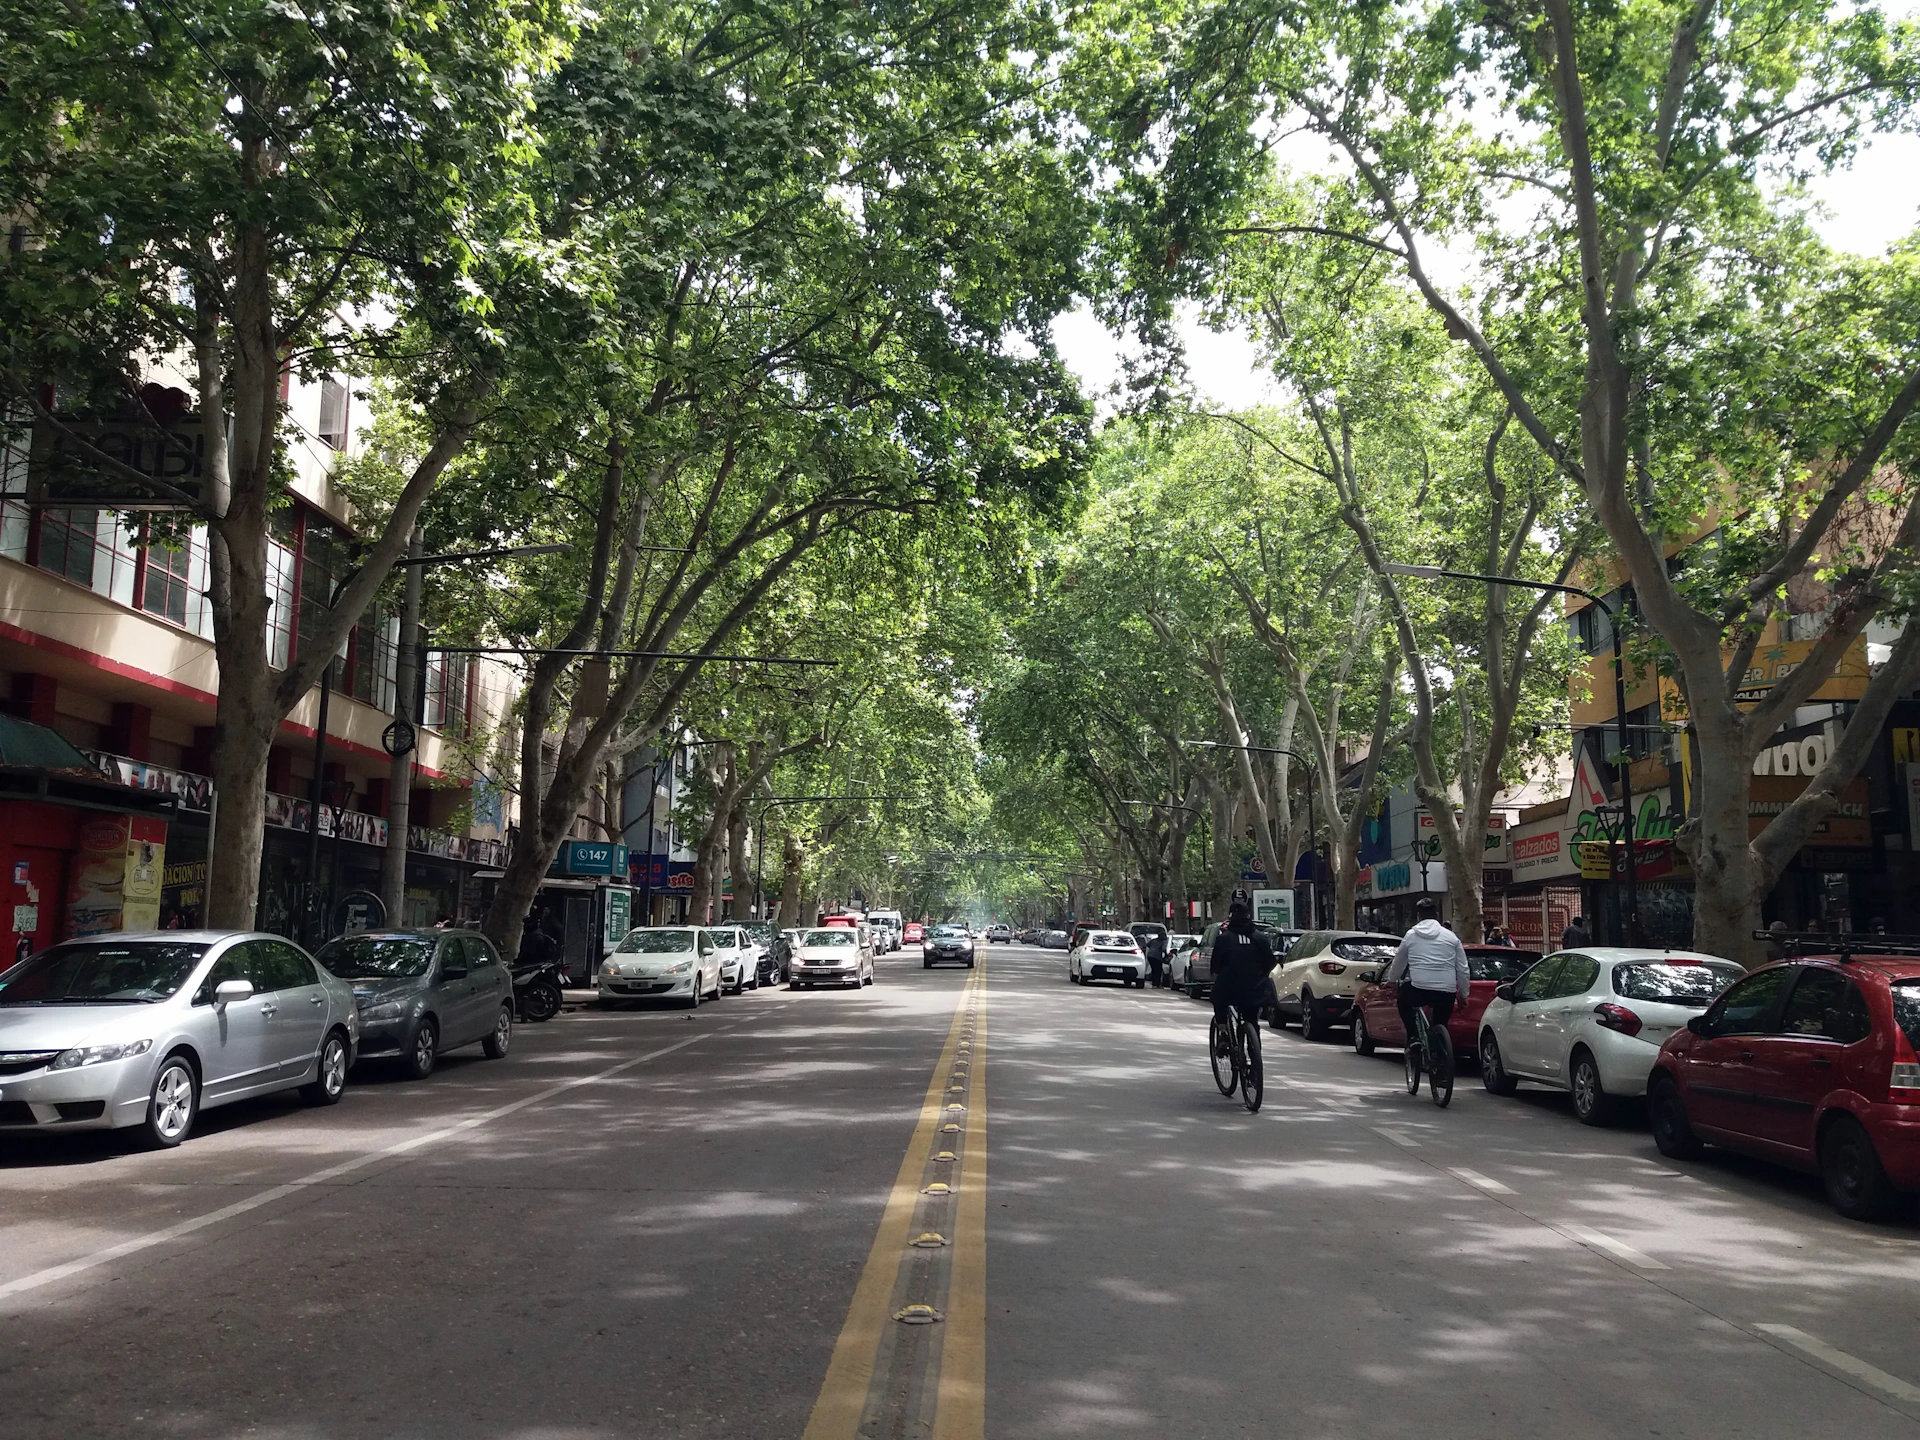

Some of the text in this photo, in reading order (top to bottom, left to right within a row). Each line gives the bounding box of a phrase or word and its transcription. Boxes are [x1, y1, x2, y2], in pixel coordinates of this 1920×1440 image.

[1514, 837, 1558, 857] calzados
[589, 850, 608, 861] 147
[1516, 860, 1535, 869] CALIDAD
[1541, 856, 1559, 865] PRECIO
[1236, 889, 1243, 898] E
